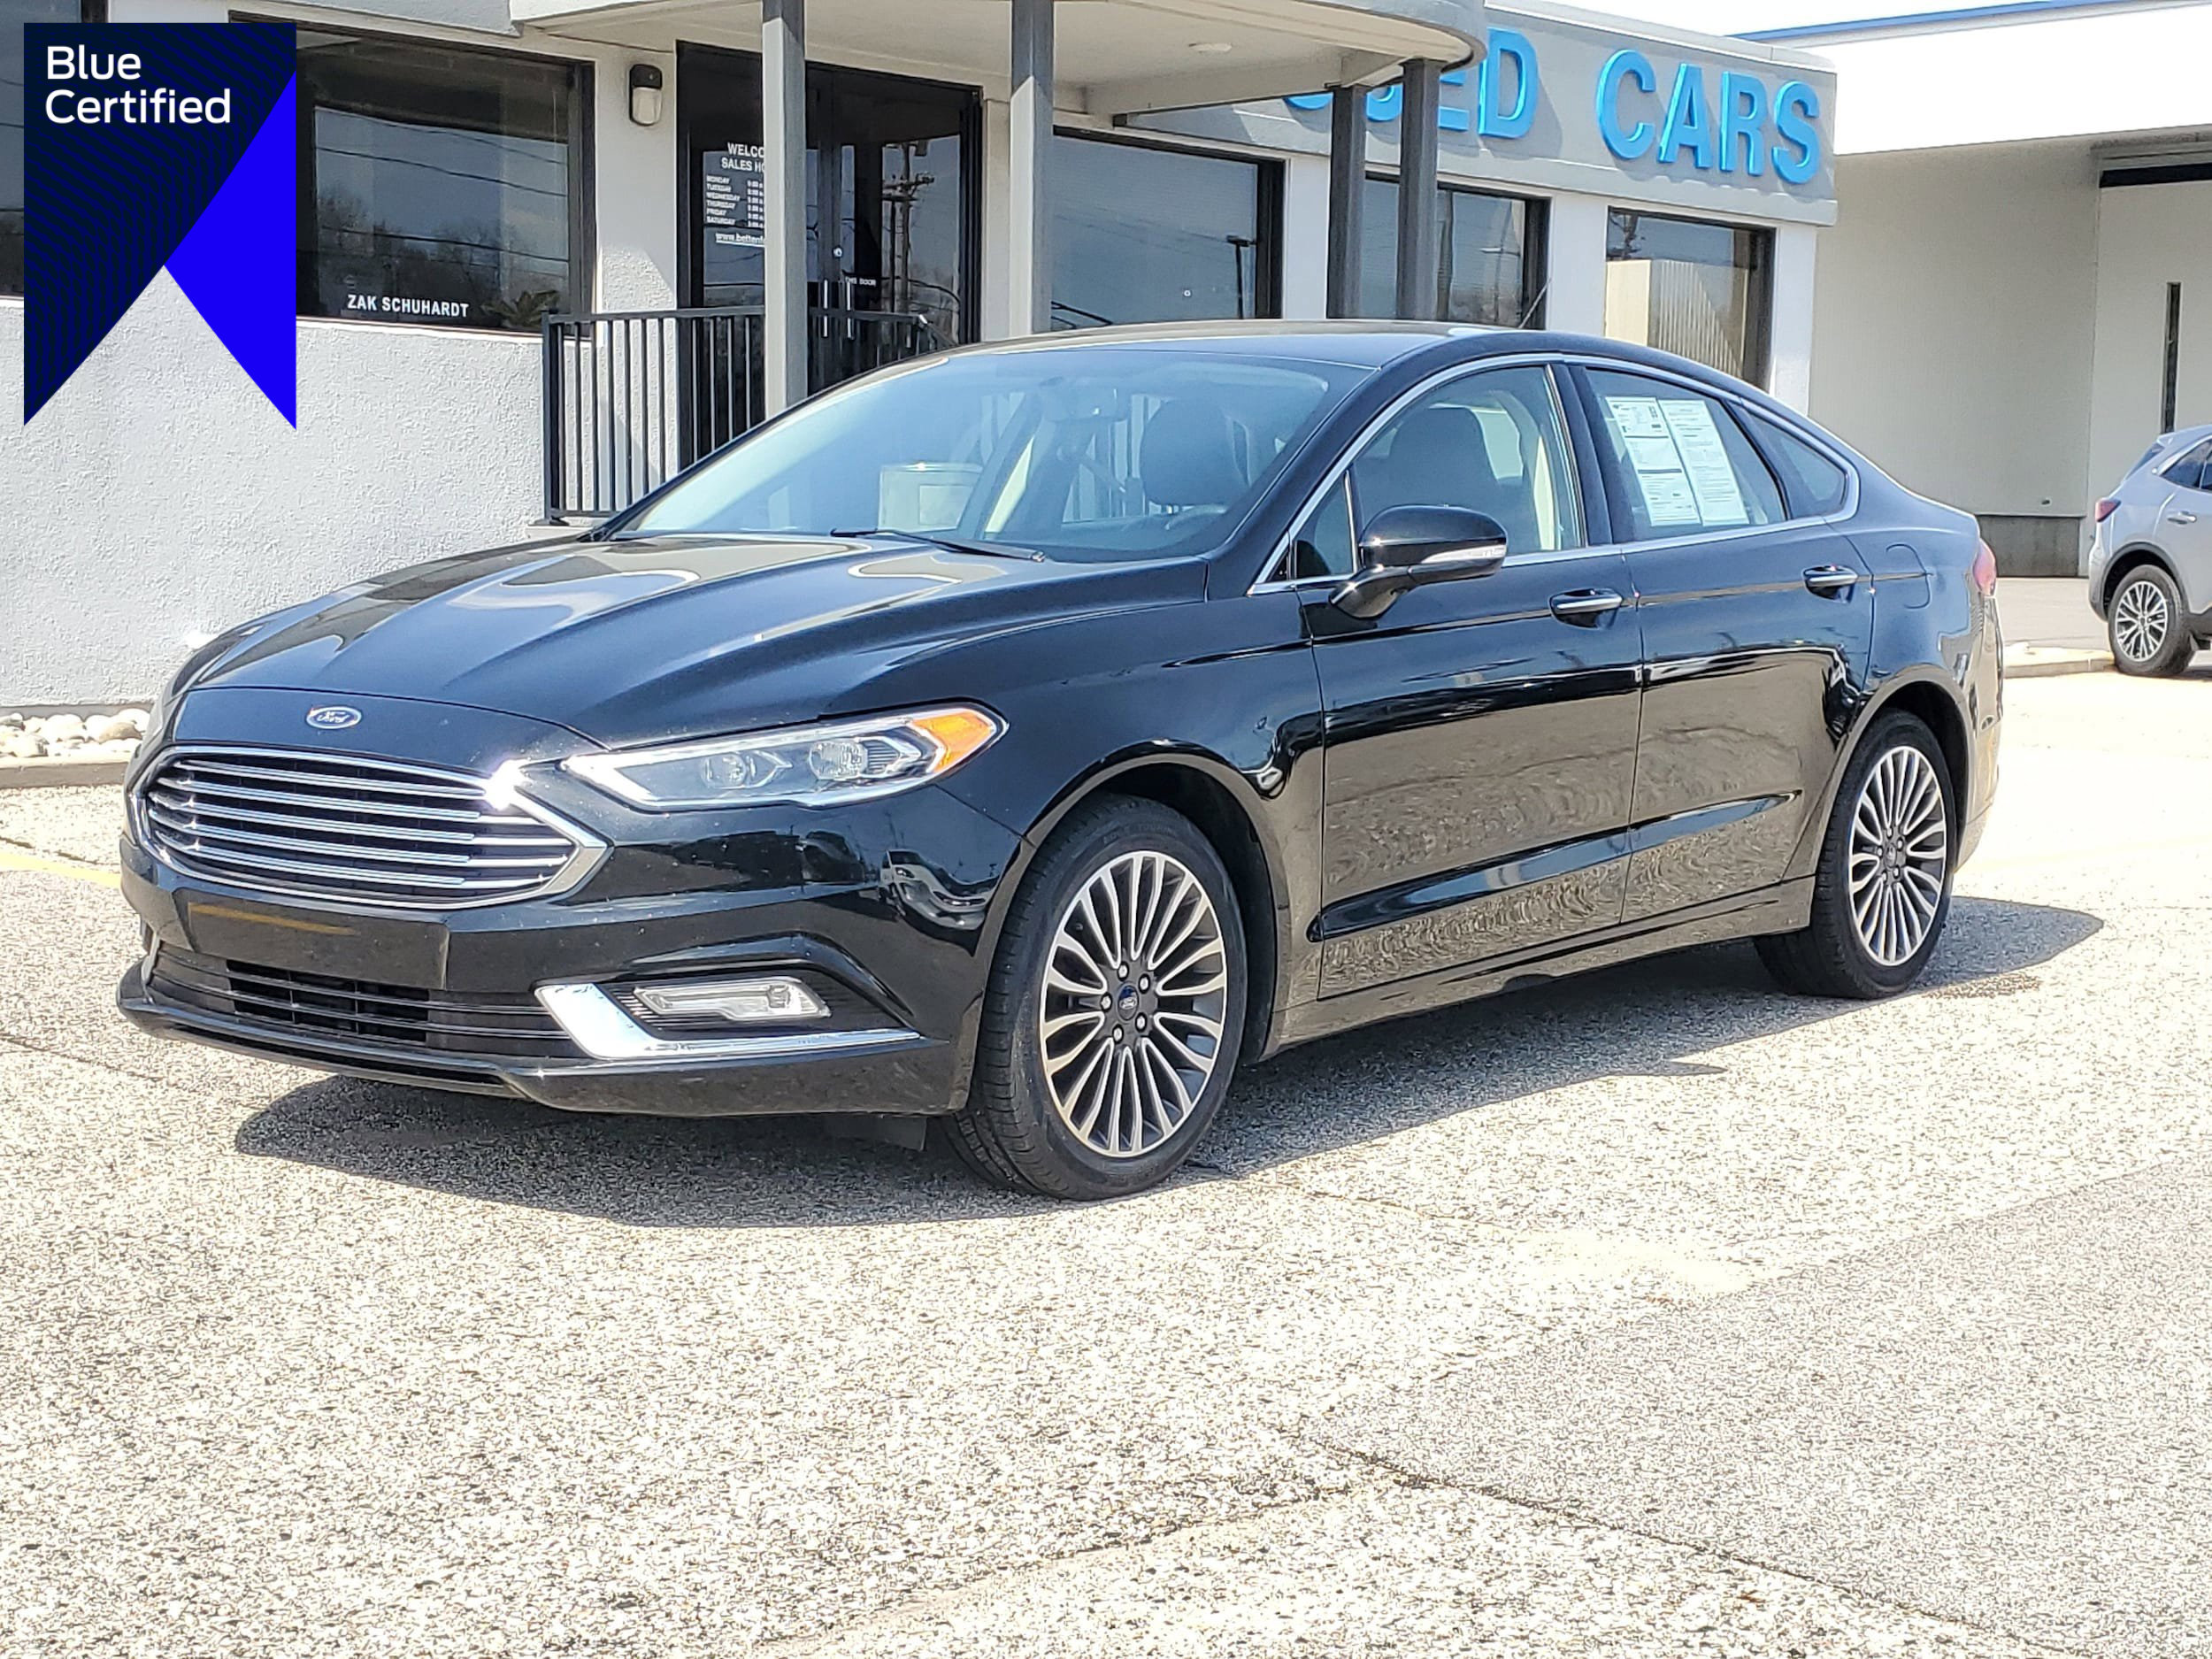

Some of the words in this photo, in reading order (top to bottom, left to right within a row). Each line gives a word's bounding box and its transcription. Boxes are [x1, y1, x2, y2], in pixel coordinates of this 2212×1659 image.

[1596, 49, 1821, 184] CARS
[727, 142, 764, 158] WELCO
[721, 157, 753, 172] SALES
[347, 294, 377, 311] ZAK
[381, 296, 469, 318] SCHUHARDT
